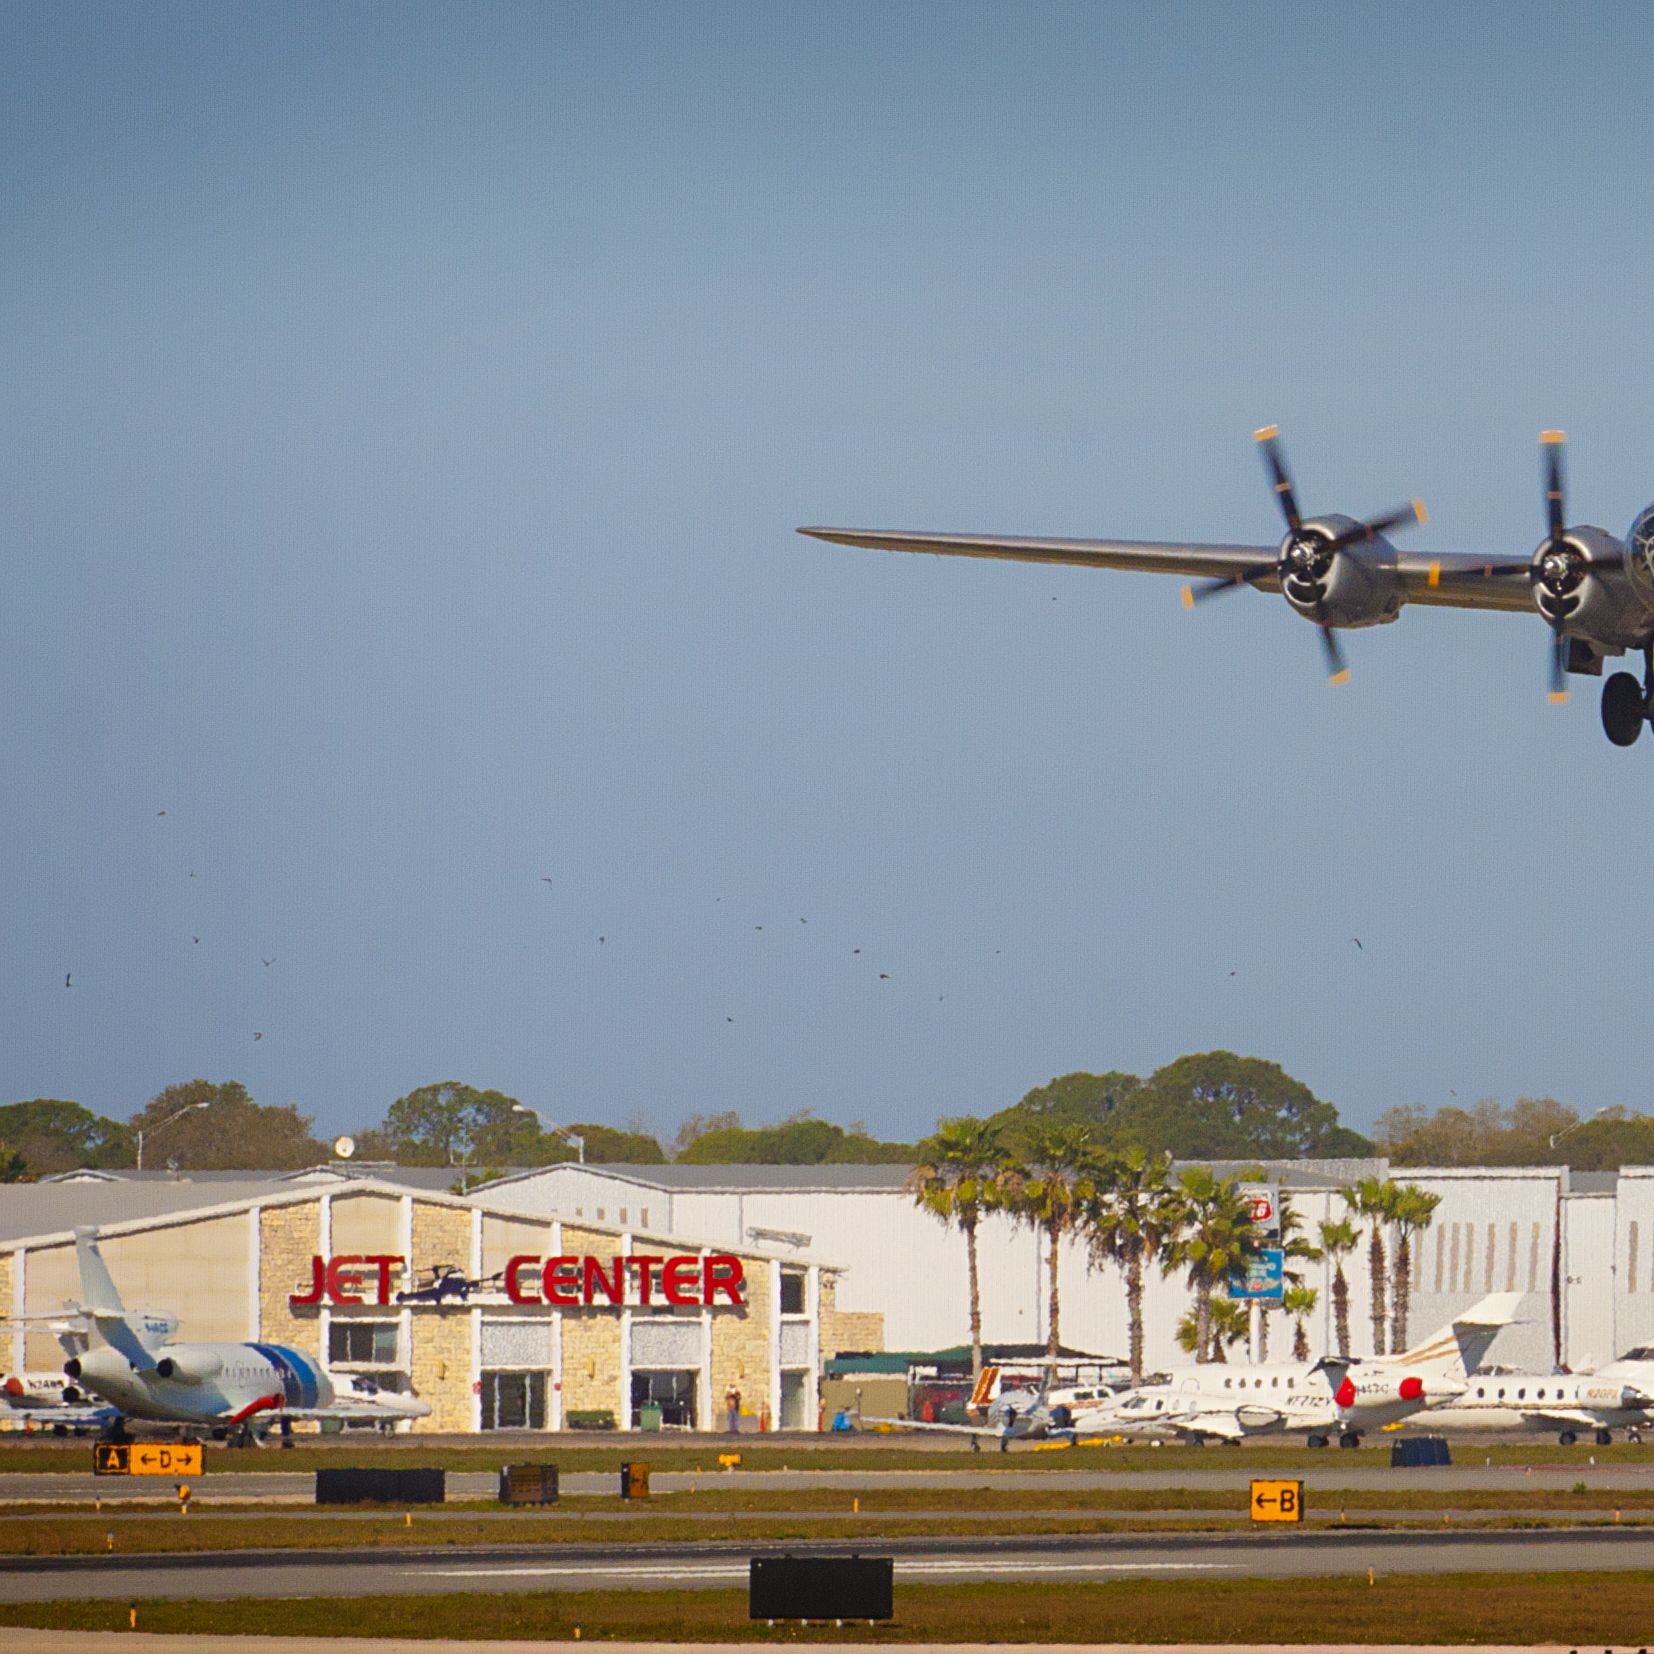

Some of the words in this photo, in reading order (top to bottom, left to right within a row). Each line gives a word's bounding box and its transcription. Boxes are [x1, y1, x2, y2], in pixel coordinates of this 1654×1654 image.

[289, 1255, 406, 1306] JET
[504, 1254, 745, 1306] CENTER
[106, 1449, 120, 1469] A
[160, 1450, 172, 1469] D
[1280, 1489, 1295, 1512] B
